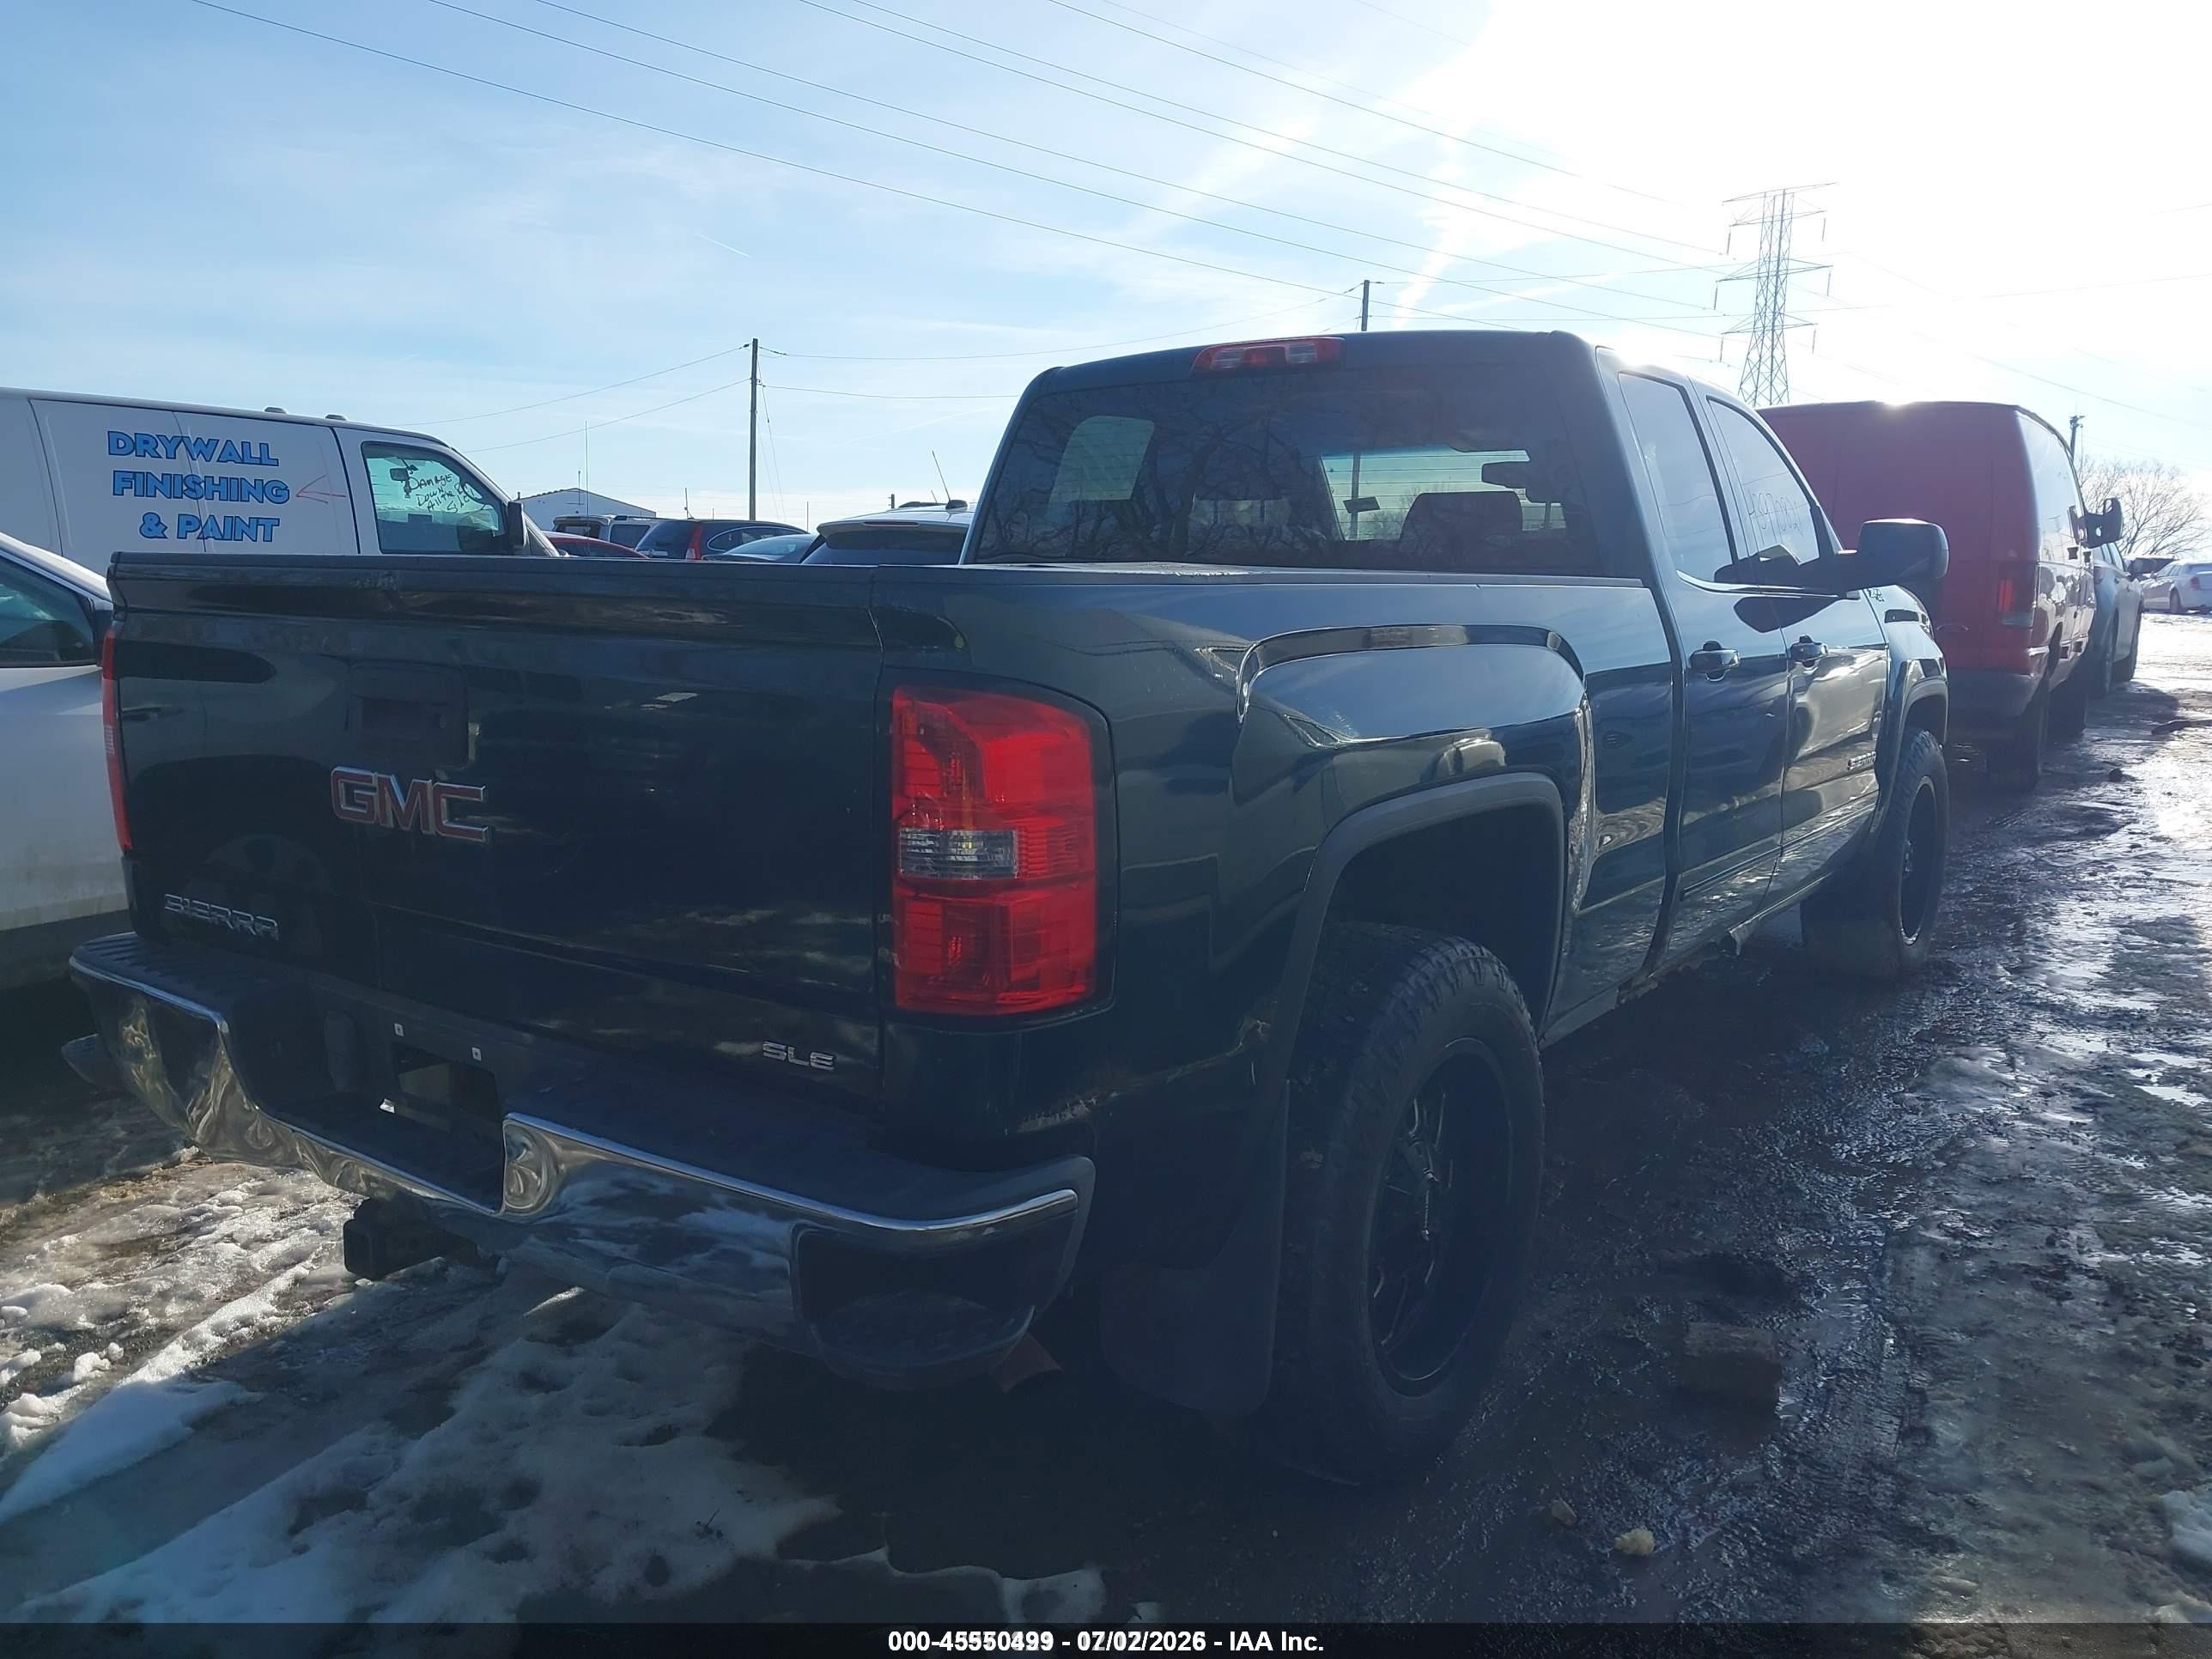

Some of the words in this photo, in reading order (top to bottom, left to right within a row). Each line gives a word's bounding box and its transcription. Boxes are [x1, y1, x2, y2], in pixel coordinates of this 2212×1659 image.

[107, 430, 279, 466] DRYWALL
[113, 470, 290, 504] FINISHING
[139, 512, 167, 538] &
[177, 513, 280, 542] PAINT
[331, 766, 489, 843] GMC
[164, 893, 280, 941] SIERRA
[763, 1040, 836, 1072] SLE
